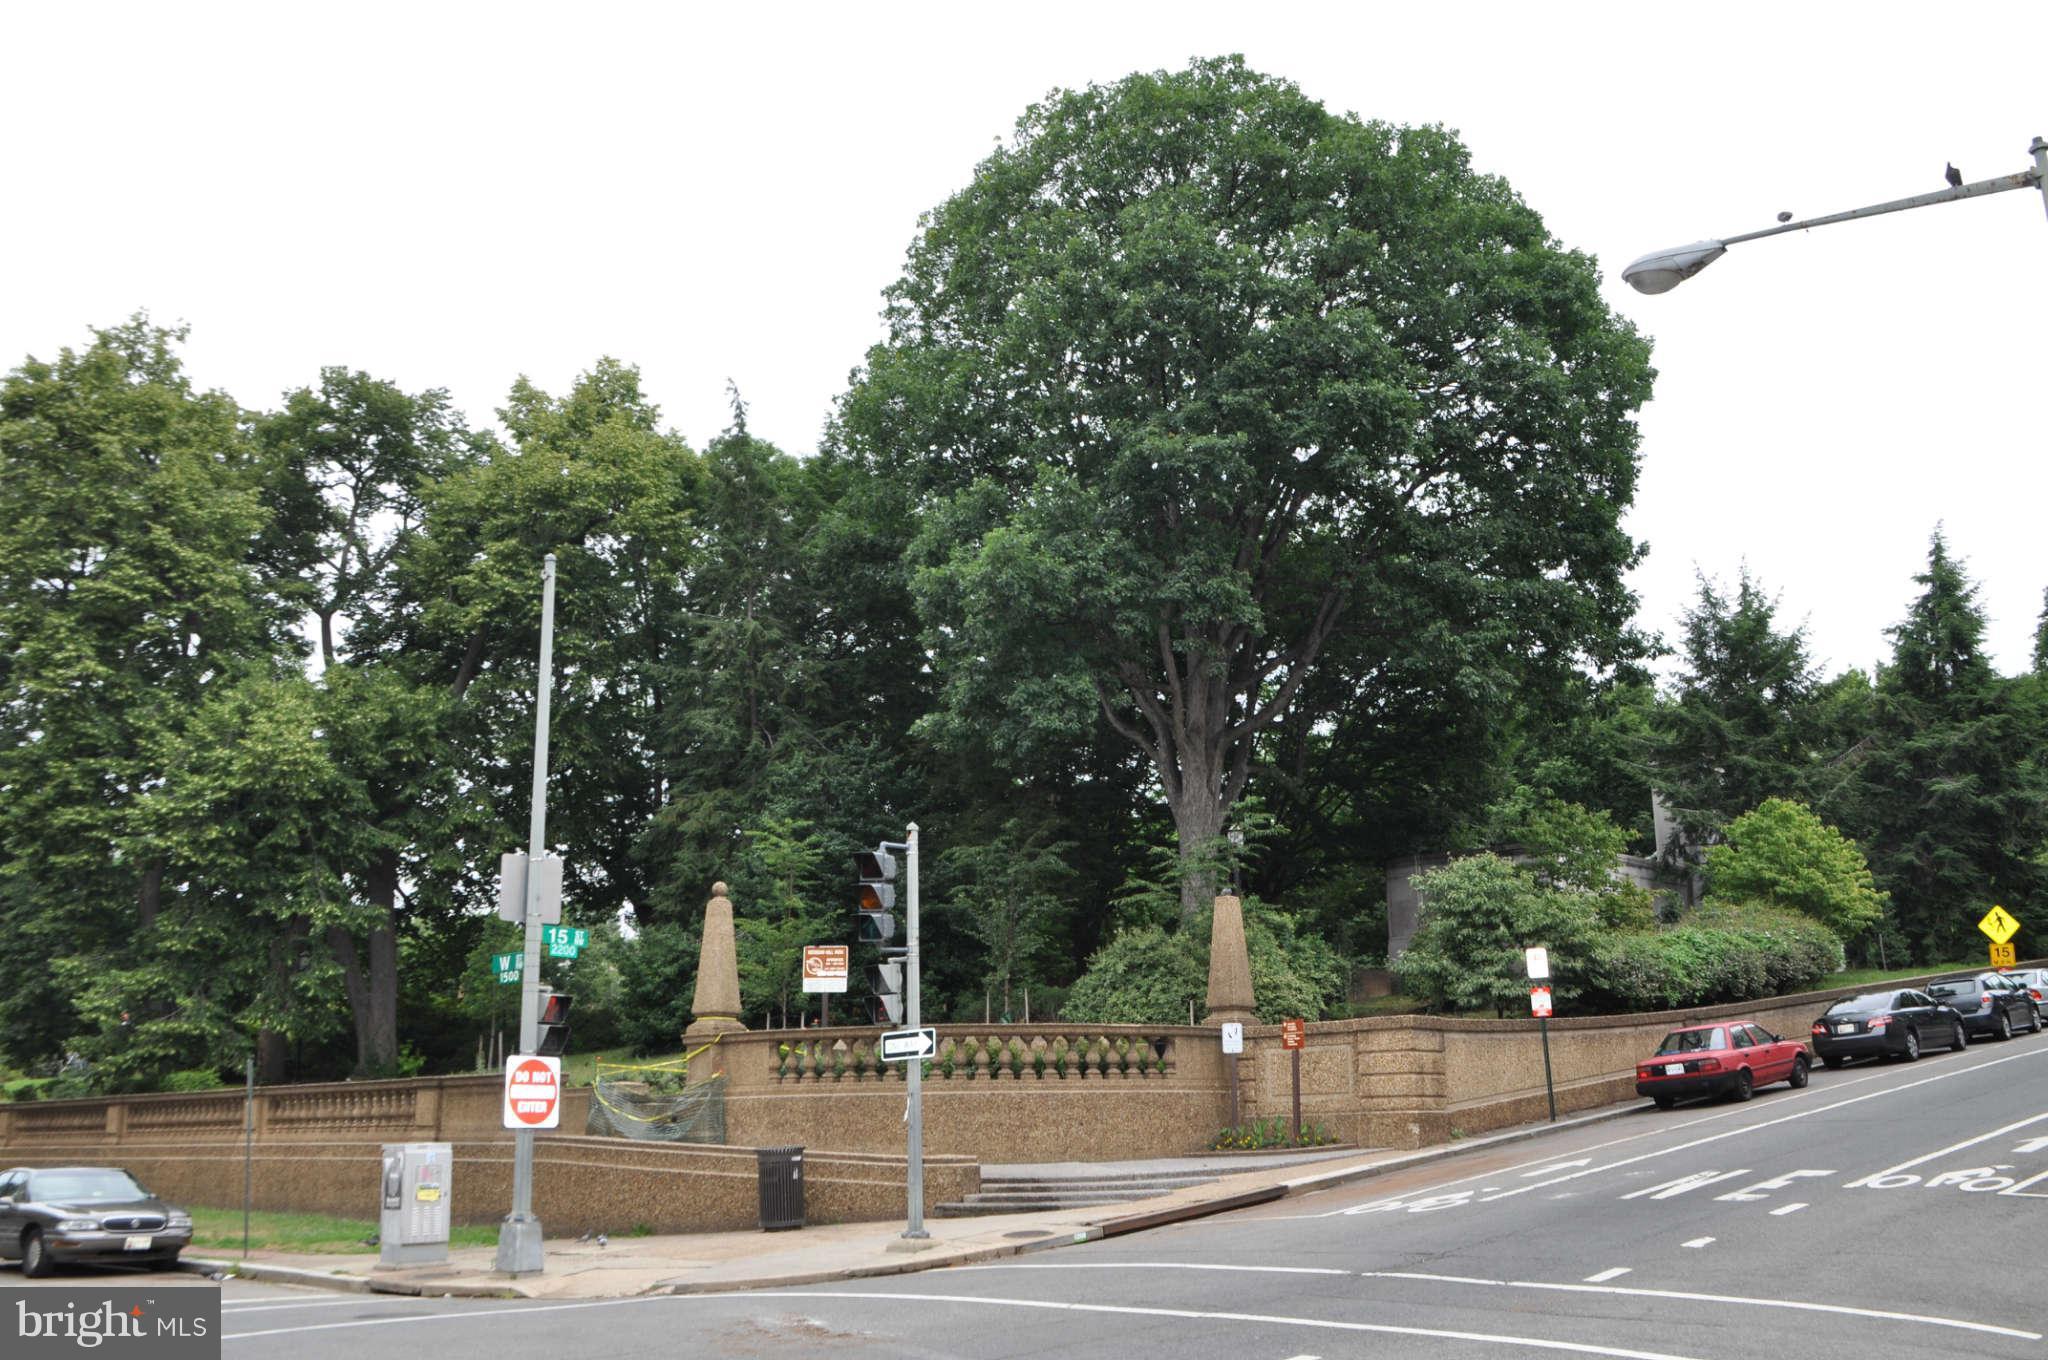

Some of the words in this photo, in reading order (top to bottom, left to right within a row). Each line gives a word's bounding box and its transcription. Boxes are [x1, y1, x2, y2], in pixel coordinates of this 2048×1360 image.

[549, 928, 568, 944] 15
[551, 944, 576, 956] 2200
[1994, 947, 2010, 958] 15
[499, 955, 511, 971] W
[500, 971, 519, 983] 1500
[515, 1070, 530, 1083] DO
[532, 1071, 553, 1084] NOT
